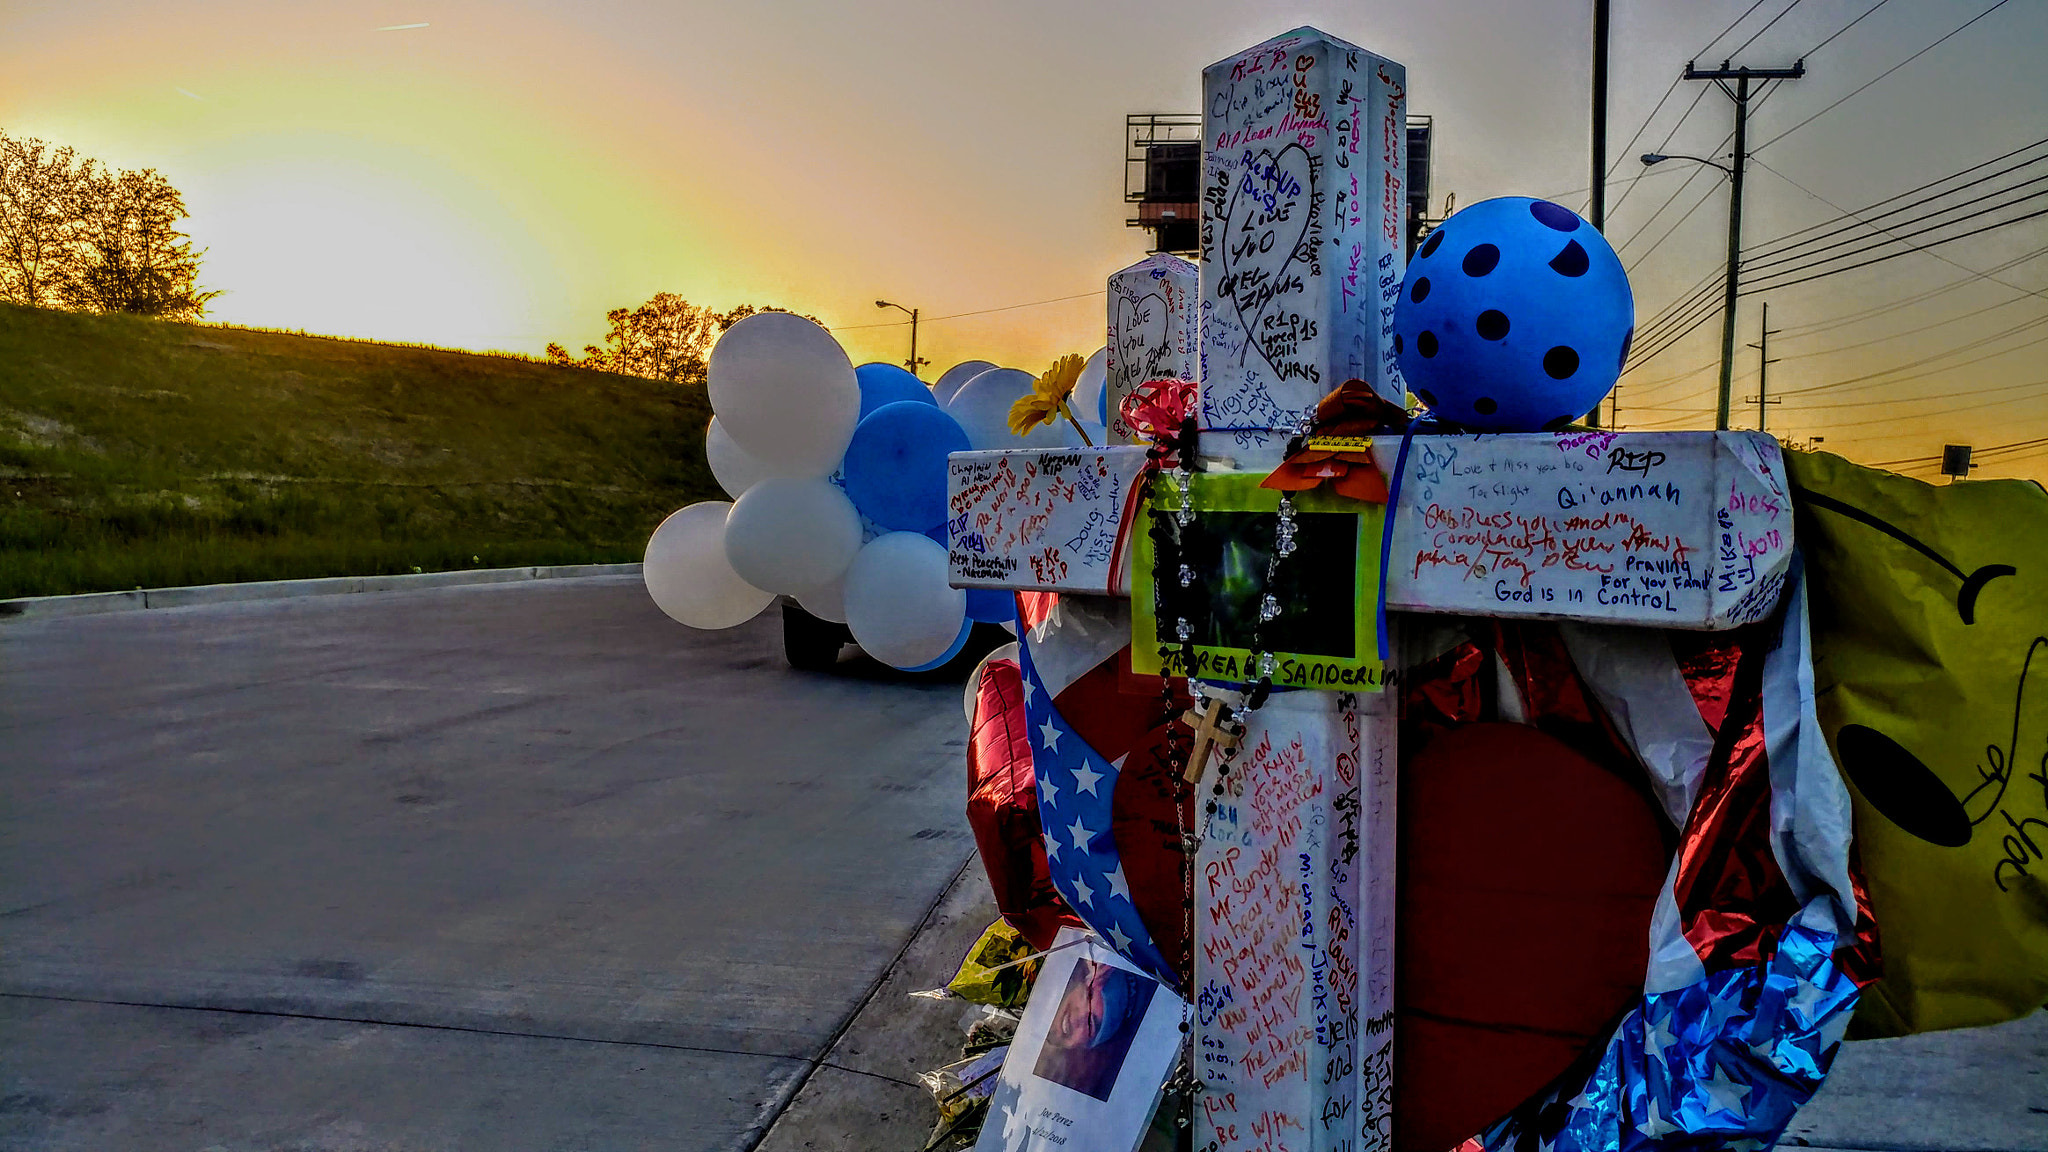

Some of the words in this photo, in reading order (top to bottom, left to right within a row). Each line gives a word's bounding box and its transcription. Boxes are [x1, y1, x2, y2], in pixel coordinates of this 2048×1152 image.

[1495, 579, 1534, 603] God
[1601, 574, 1631, 590] For
[1038, 1107, 1052, 1119] Joe
[1050, 1110, 1075, 1128] Perez
